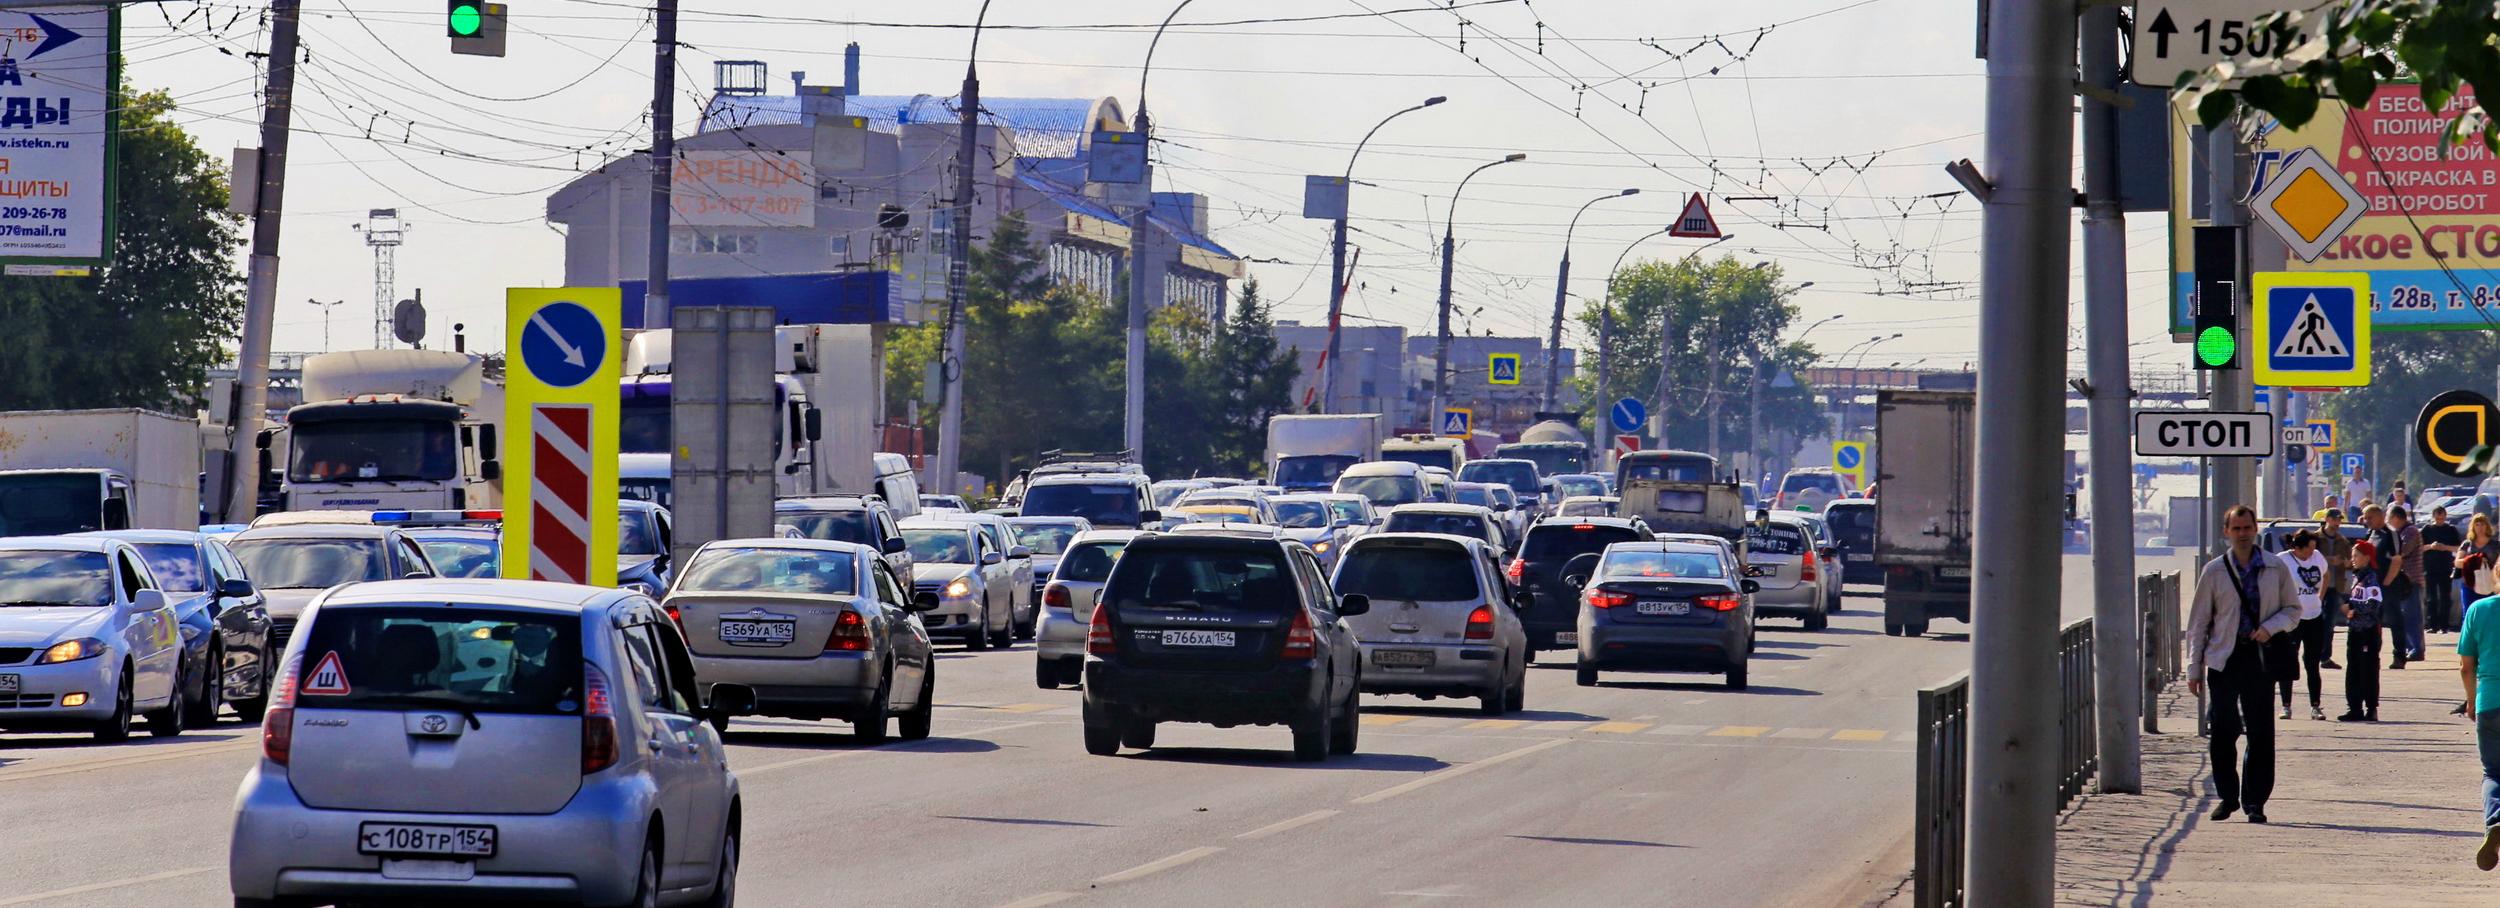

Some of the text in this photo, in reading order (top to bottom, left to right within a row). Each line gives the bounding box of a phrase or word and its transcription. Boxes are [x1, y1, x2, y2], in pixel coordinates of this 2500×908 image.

[0, 96, 70, 129] ДЫ
[672, 159, 802, 188] АРЕНДА
[2367, 170, 2496, 186] ПОКРАСКА В
[3, 207, 67, 219] 209-26-78
[2158, 420, 2250, 447] СТОП
[772, 624, 792, 634] 154
[1215, 632, 1233, 642] 154
[318, 672, 337, 687] Ш
[457, 830, 491, 846] 154
